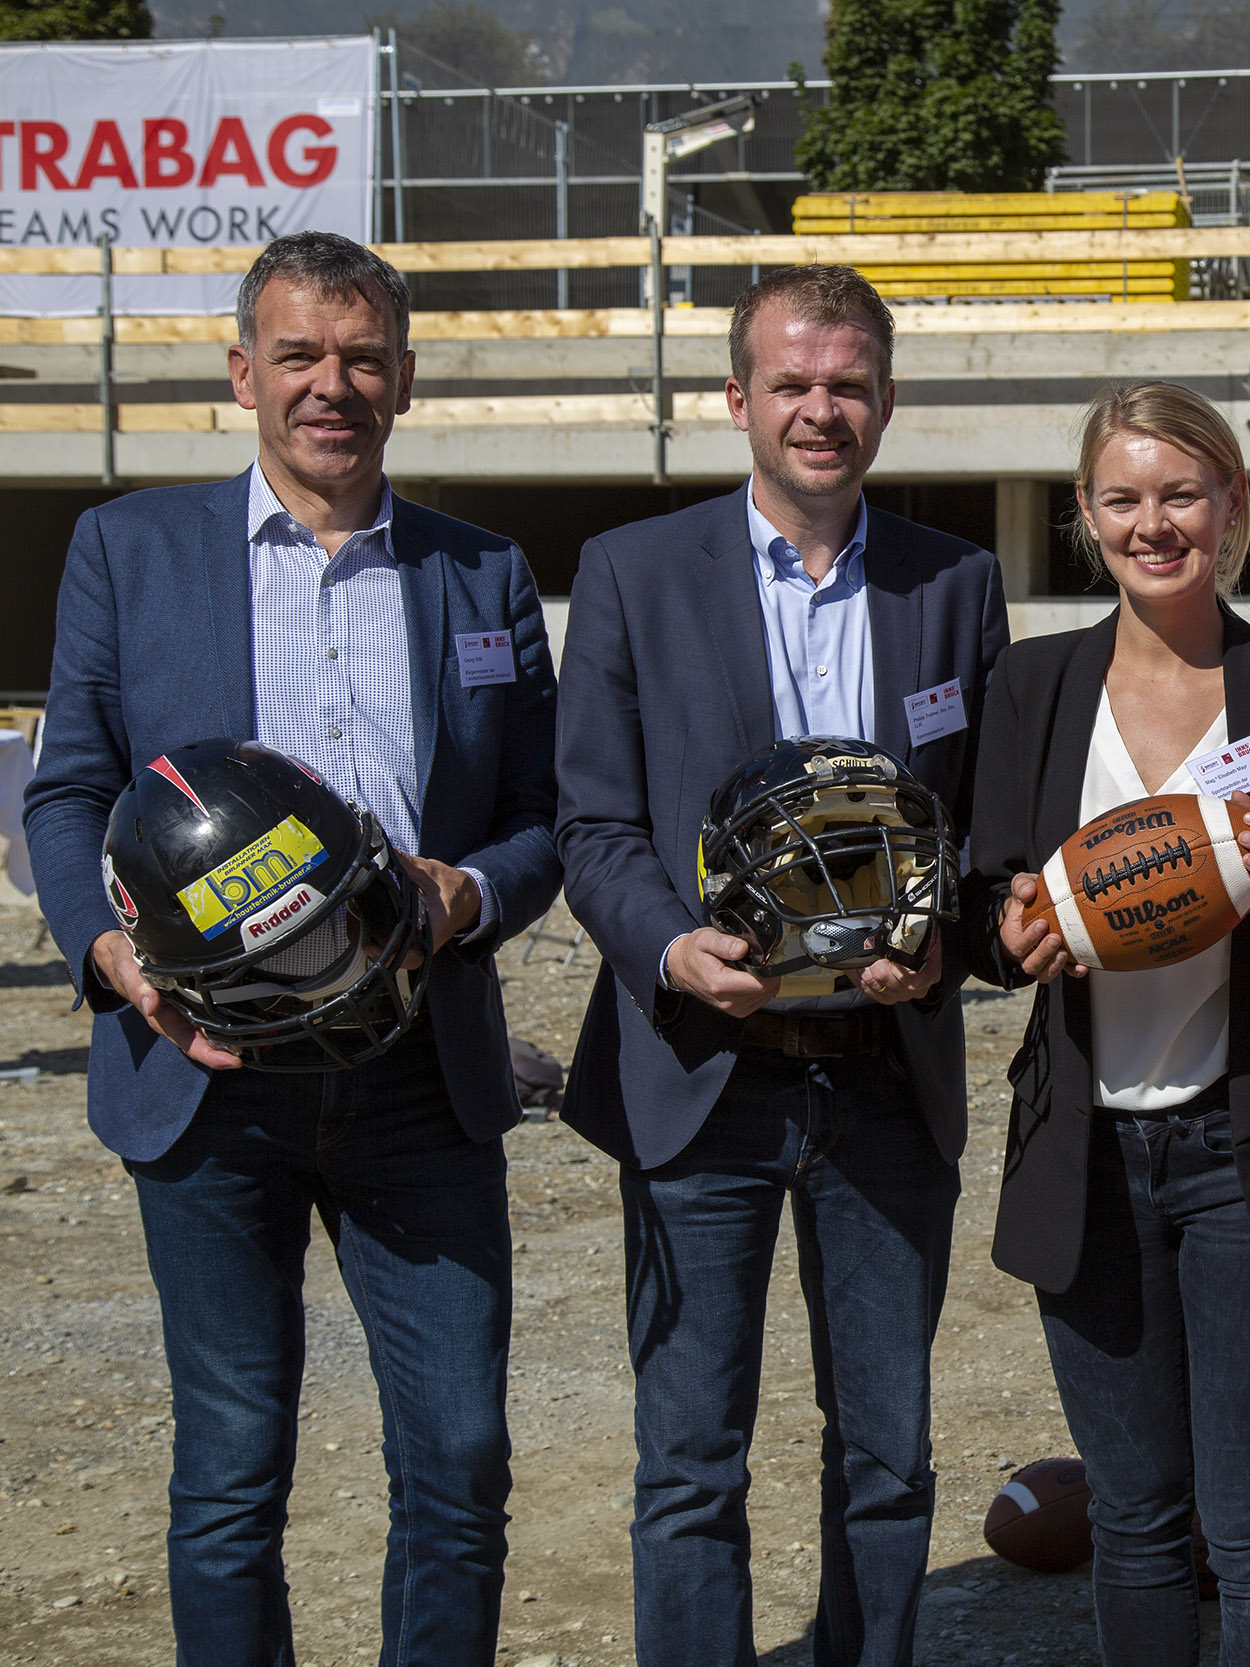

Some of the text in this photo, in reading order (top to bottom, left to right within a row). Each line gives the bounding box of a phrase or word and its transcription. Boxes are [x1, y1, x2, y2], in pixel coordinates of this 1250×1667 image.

[140, 205, 281, 242] WORK
[218, 835, 271, 874] INSTALLATIONEN
[224, 841, 272, 876] BRUNNER MAX
[204, 849, 295, 913] bm
[248, 889, 312, 938] Riddell
